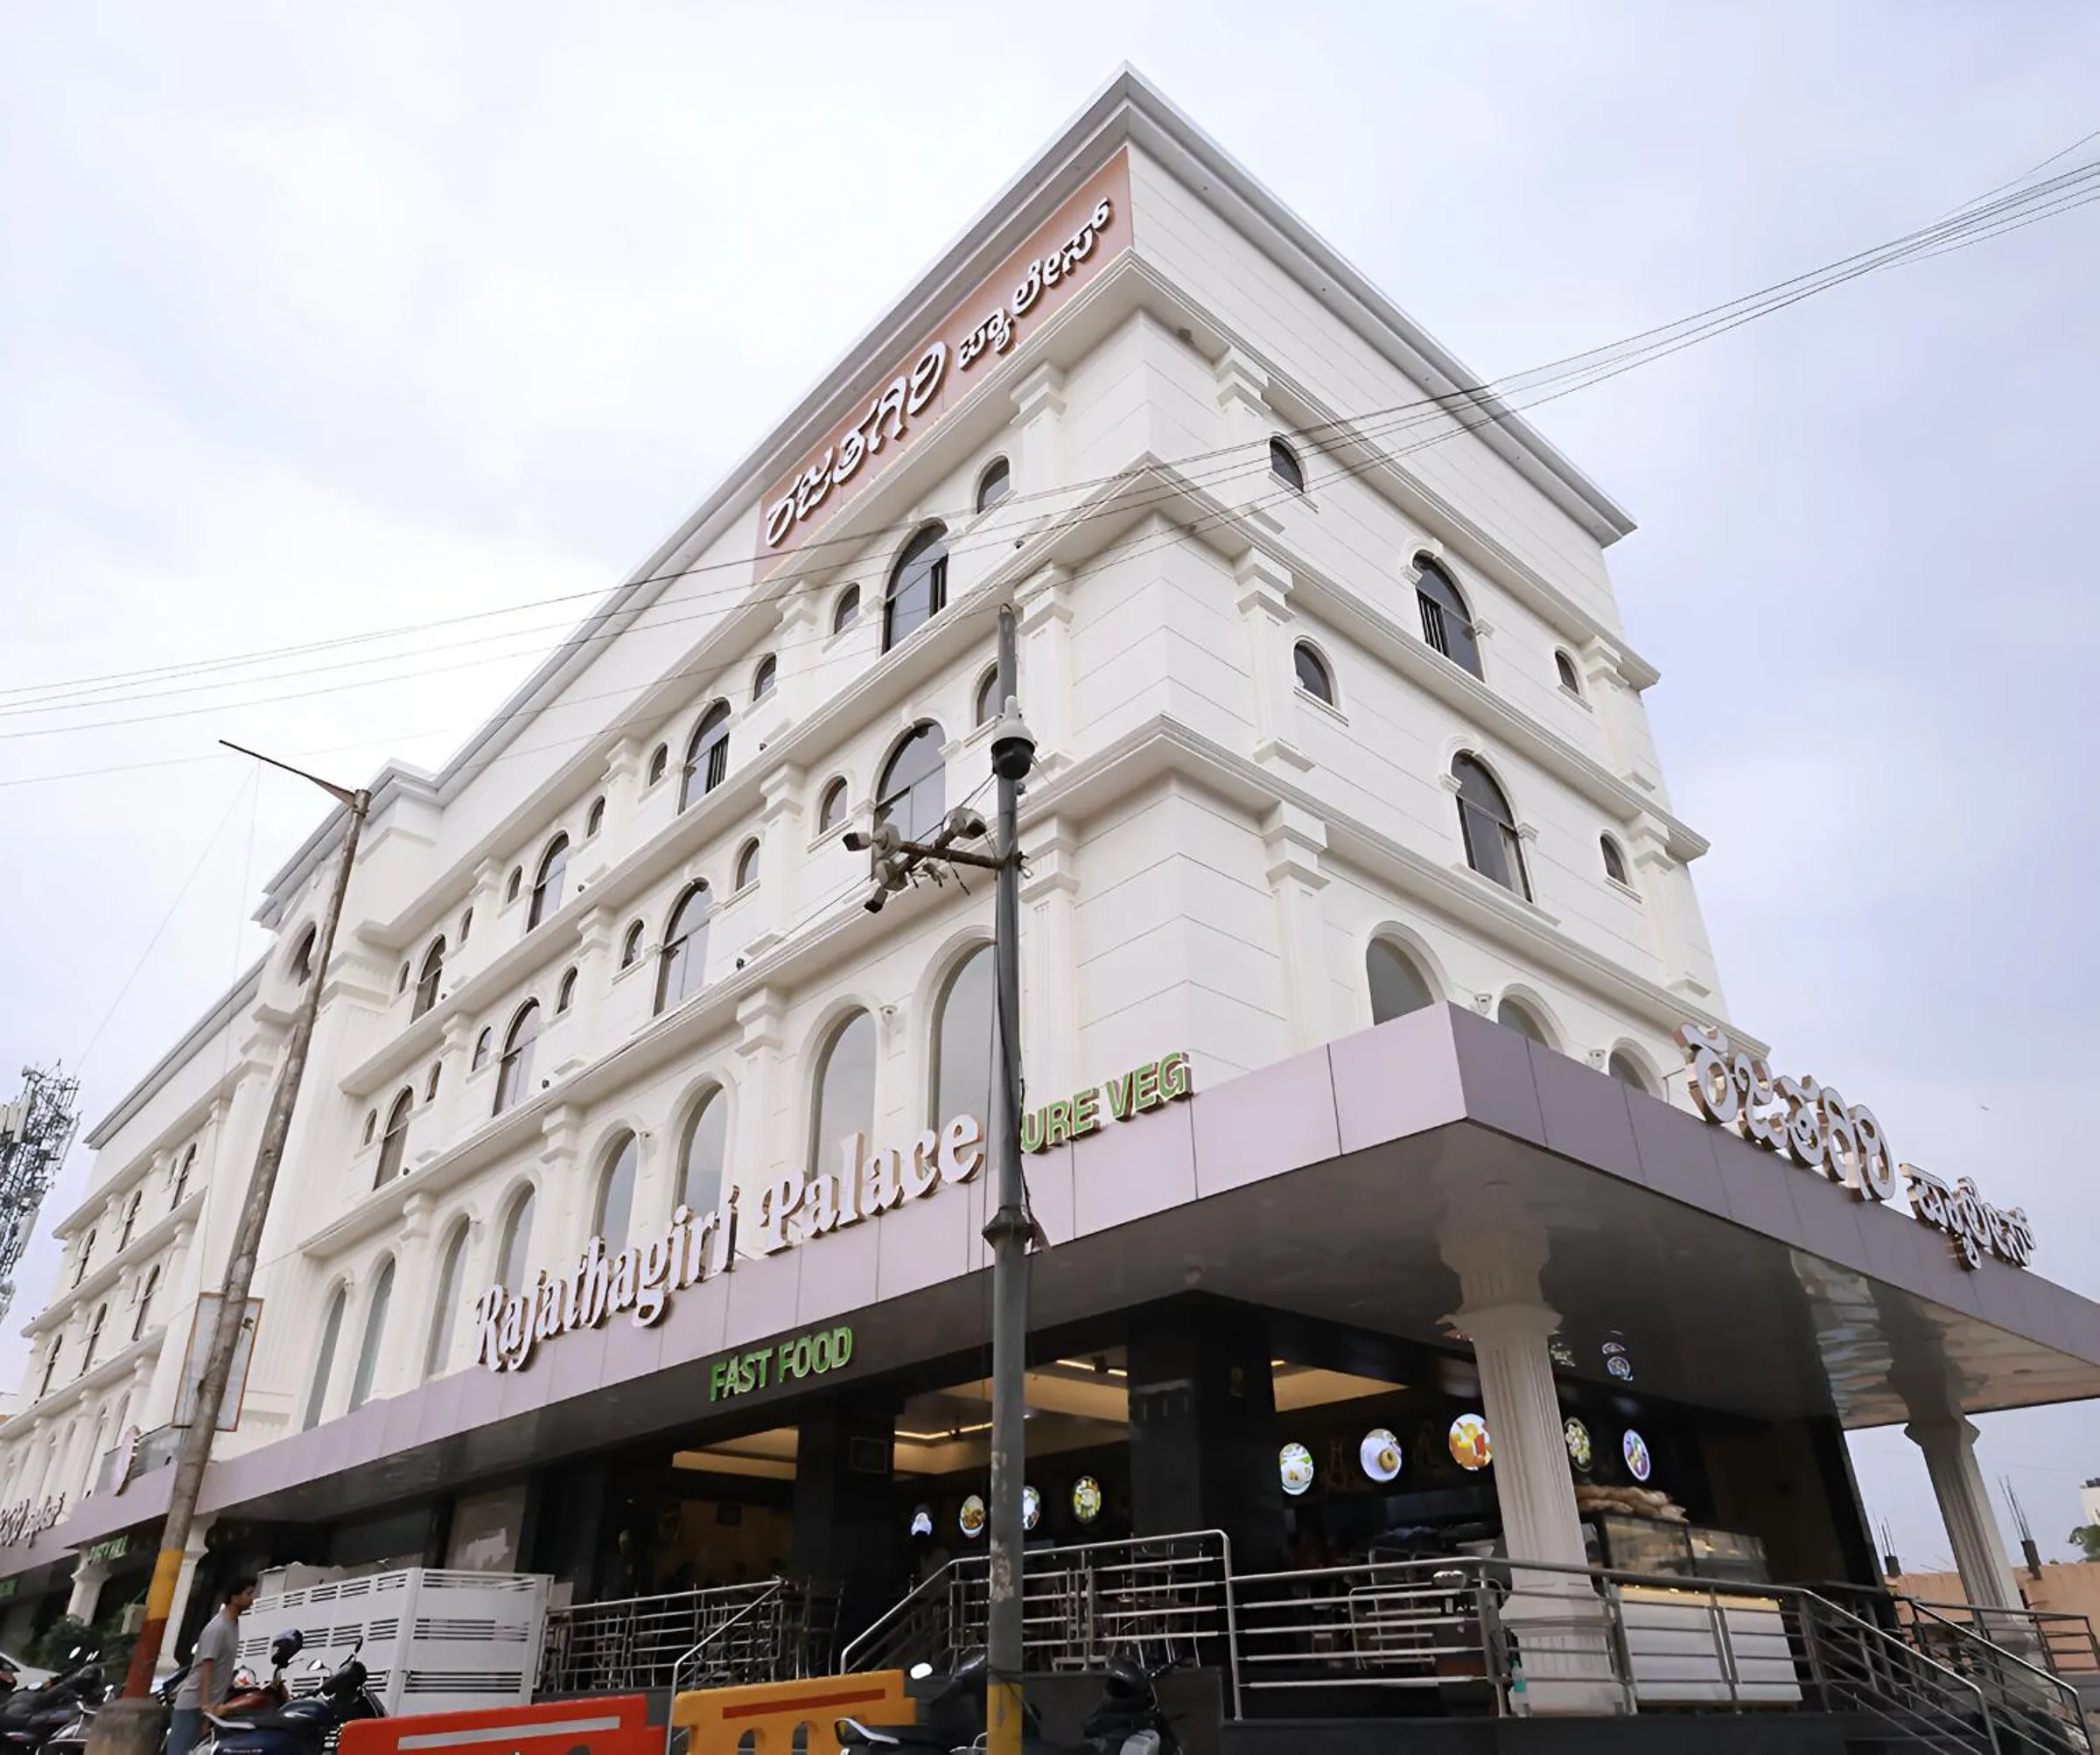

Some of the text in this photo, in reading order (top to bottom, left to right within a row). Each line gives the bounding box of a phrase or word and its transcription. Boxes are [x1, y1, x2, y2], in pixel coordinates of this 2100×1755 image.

[765, 340, 952, 549] ರಜತಗಿರಿ
[1019, 1052, 1193, 1154] URE VEG
[475, 1113, 985, 1374] Rajathagiri Palace
[710, 1325, 853, 1402] FAST FOOD
